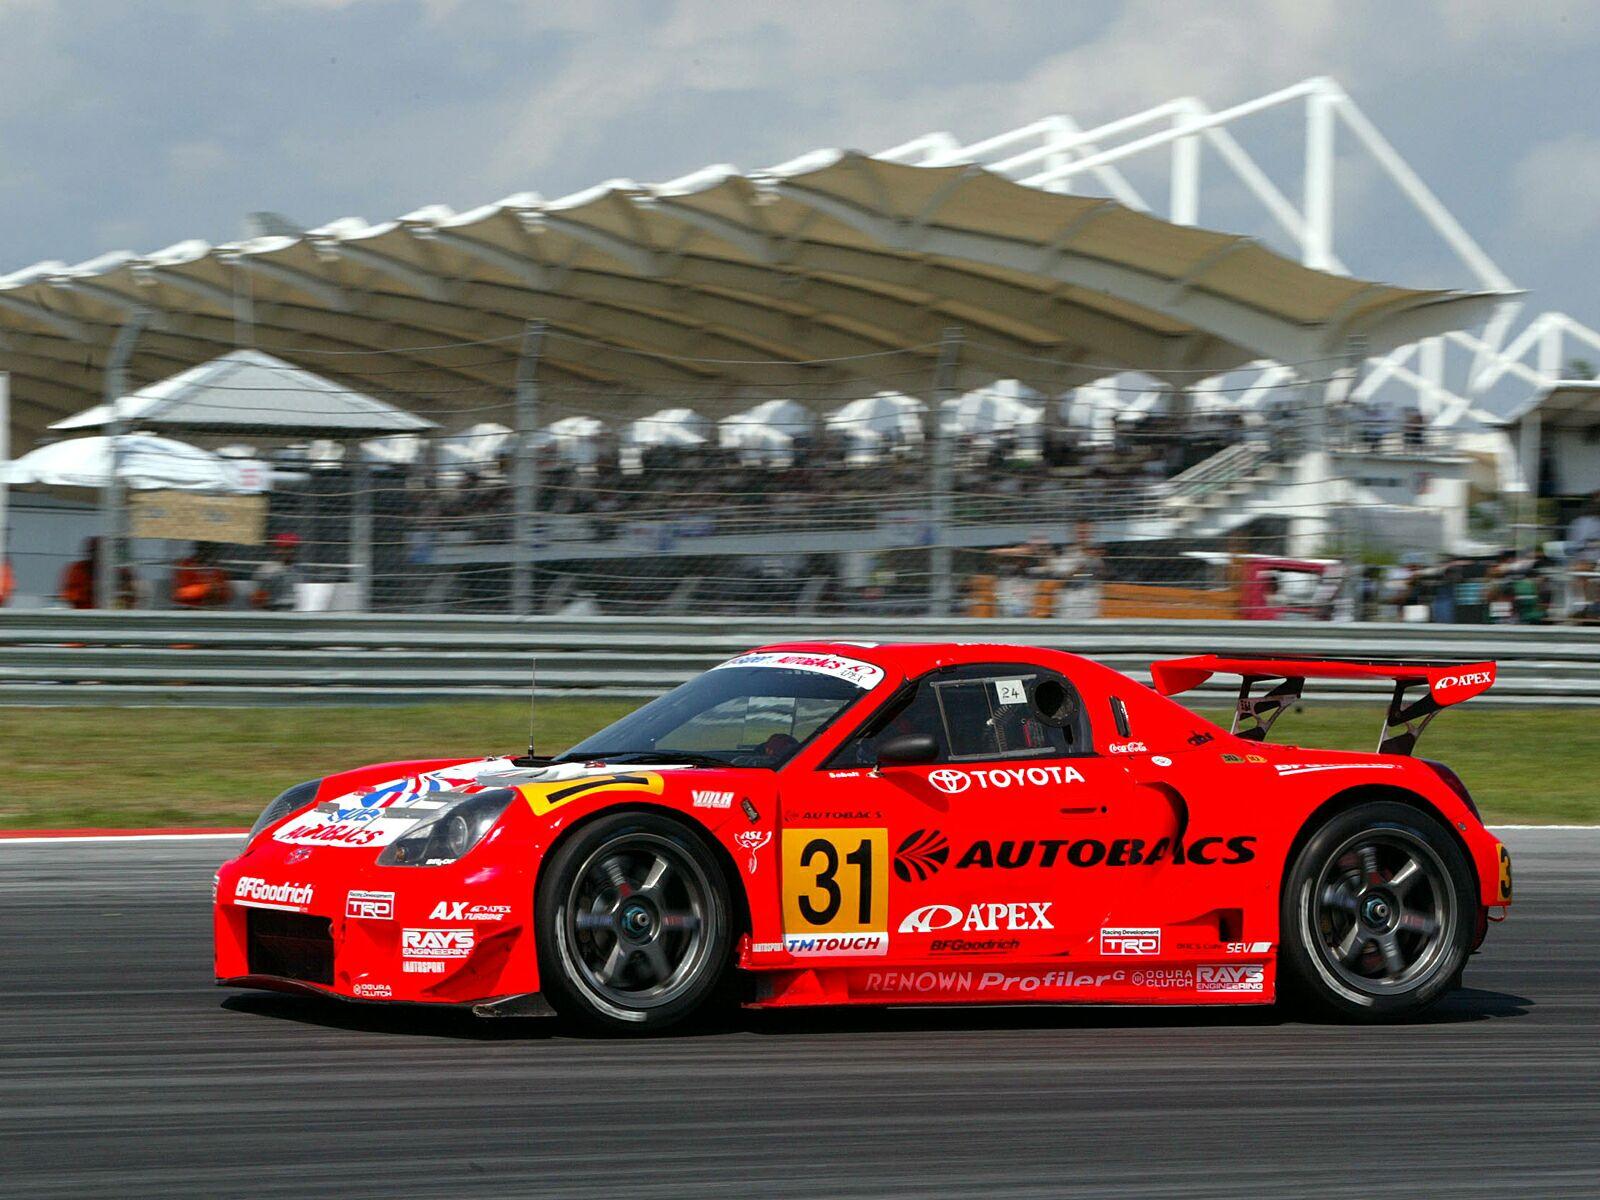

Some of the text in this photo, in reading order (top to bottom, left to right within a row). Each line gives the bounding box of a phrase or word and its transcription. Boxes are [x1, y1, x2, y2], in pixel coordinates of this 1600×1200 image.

[1001, 687, 1020, 699] 24
[970, 766, 1085, 789] TOYOTA
[955, 836, 1257, 868] AUTOBACS
[234, 876, 314, 904] BFGoodrich
[798, 839, 872, 925] 31
[348, 901, 390, 917] TRD
[429, 901, 470, 920] AX
[402, 931, 475, 949] RAYS
[929, 939, 1021, 951] BFGoodrich
[1104, 939, 1156, 954] TRD
[1226, 943, 1251, 953] SEV
[864, 972, 972, 993] RENOWN
[1146, 970, 1193, 979] OGURA
[1196, 967, 1265, 983] RAYS
[1145, 979, 1194, 988] CLUTCH
